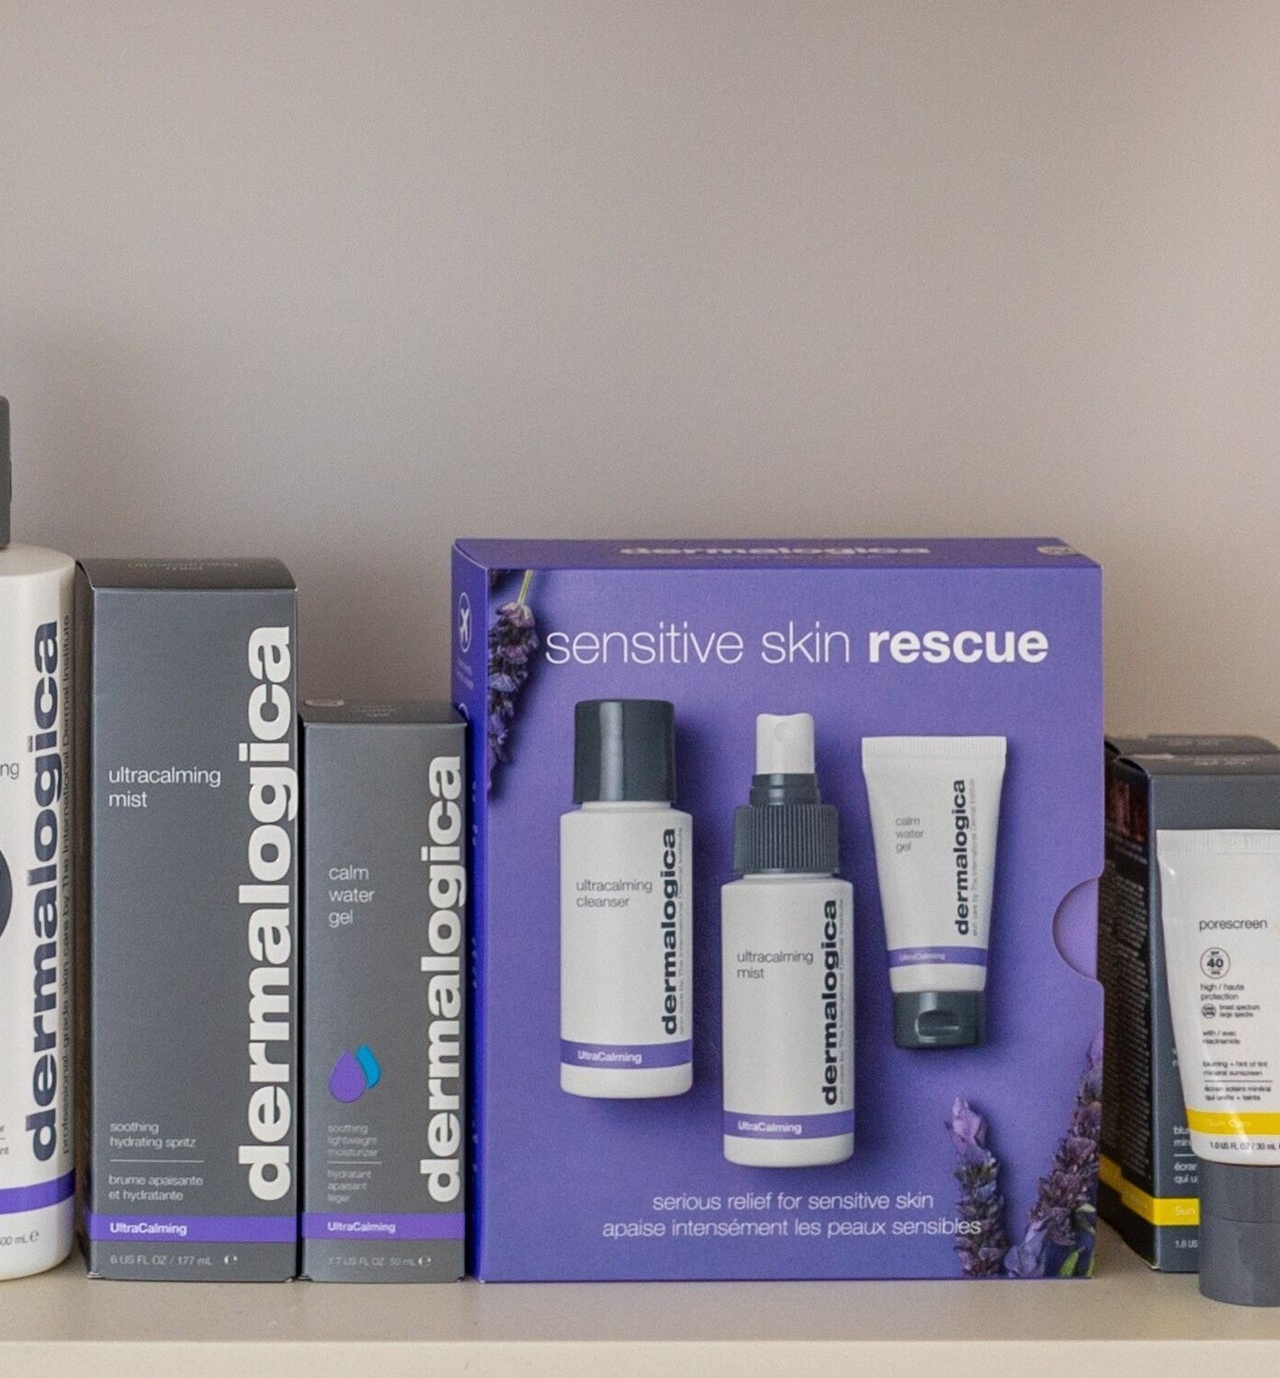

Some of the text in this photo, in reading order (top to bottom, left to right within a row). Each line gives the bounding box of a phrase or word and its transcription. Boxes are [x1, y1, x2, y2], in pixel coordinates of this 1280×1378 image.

[546, 621, 1048, 664] sensitive skin rescue
[108, 766, 221, 787] ultracalming
[109, 791, 147, 808] mist
[952, 780, 970, 936] dermalogica
[329, 866, 368, 880] calm
[24, 620, 62, 1162] dermalogica
[329, 889, 374, 902] water
[238, 625, 298, 1201] dermalogica
[329, 910, 353, 927] gel
[660, 828, 680, 1036] dermalogica
[1199, 919, 1268, 931] porescreen
[420, 755, 466, 1203] dermalogica
[821, 900, 841, 1106] dermalogica
[653, 1192, 933, 1209] serious relief for sensitive skin
[110, 1223, 187, 1235] UltraCalming
